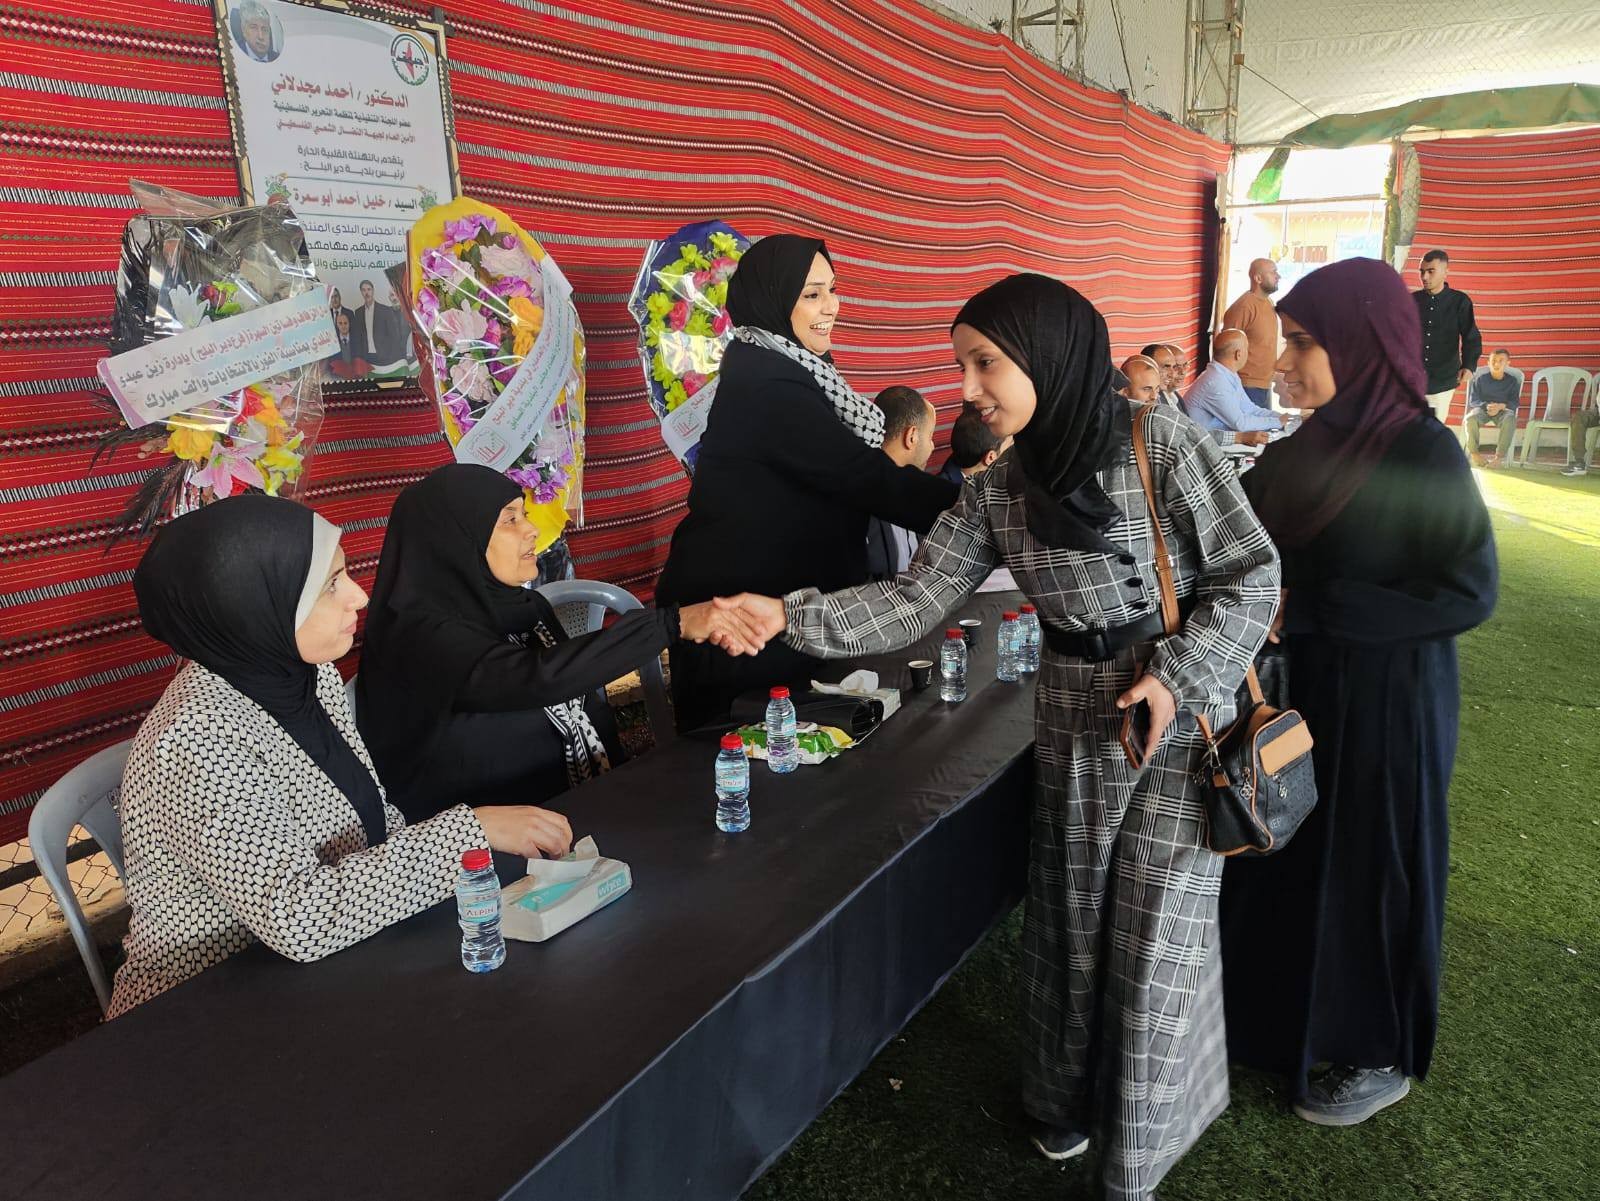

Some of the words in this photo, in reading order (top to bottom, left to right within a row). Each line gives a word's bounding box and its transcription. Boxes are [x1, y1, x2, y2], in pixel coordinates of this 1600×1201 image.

[271, 73, 321, 98] مجدلاني
[297, 145, 320, 157] الحارة
[333, 164, 344, 174] دير
[293, 187, 319, 205] سمرة
[363, 194, 386, 210] خليل
[394, 198, 418, 212] السيد
[331, 223, 360, 236] البلدي
[361, 225, 396, 236] المجلس
[144, 389, 180, 409] مبارك
